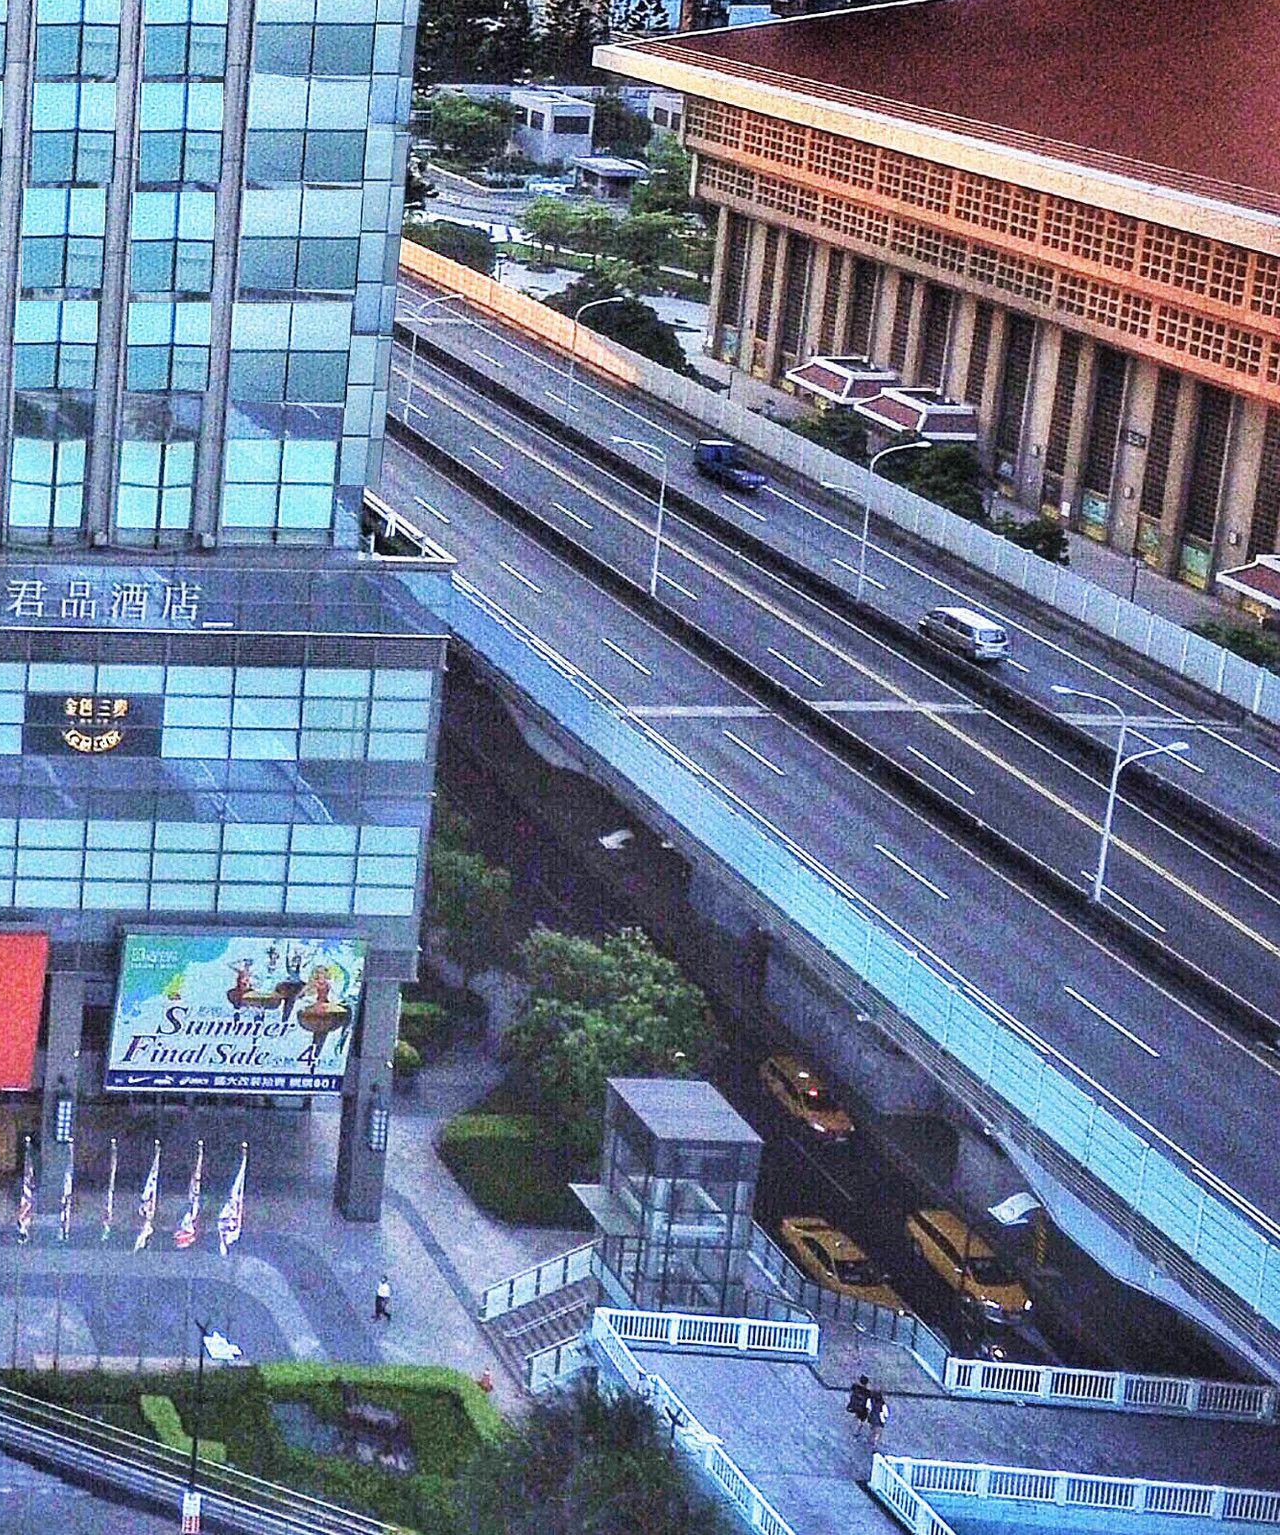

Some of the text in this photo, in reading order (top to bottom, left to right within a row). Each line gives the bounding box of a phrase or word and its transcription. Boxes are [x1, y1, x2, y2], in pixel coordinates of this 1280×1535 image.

[6, 579, 203, 621] 君品酒店
[156, 1006, 297, 1039] Summer
[122, 1035, 208, 1064] Final
[209, 1042, 271, 1066] Sale
